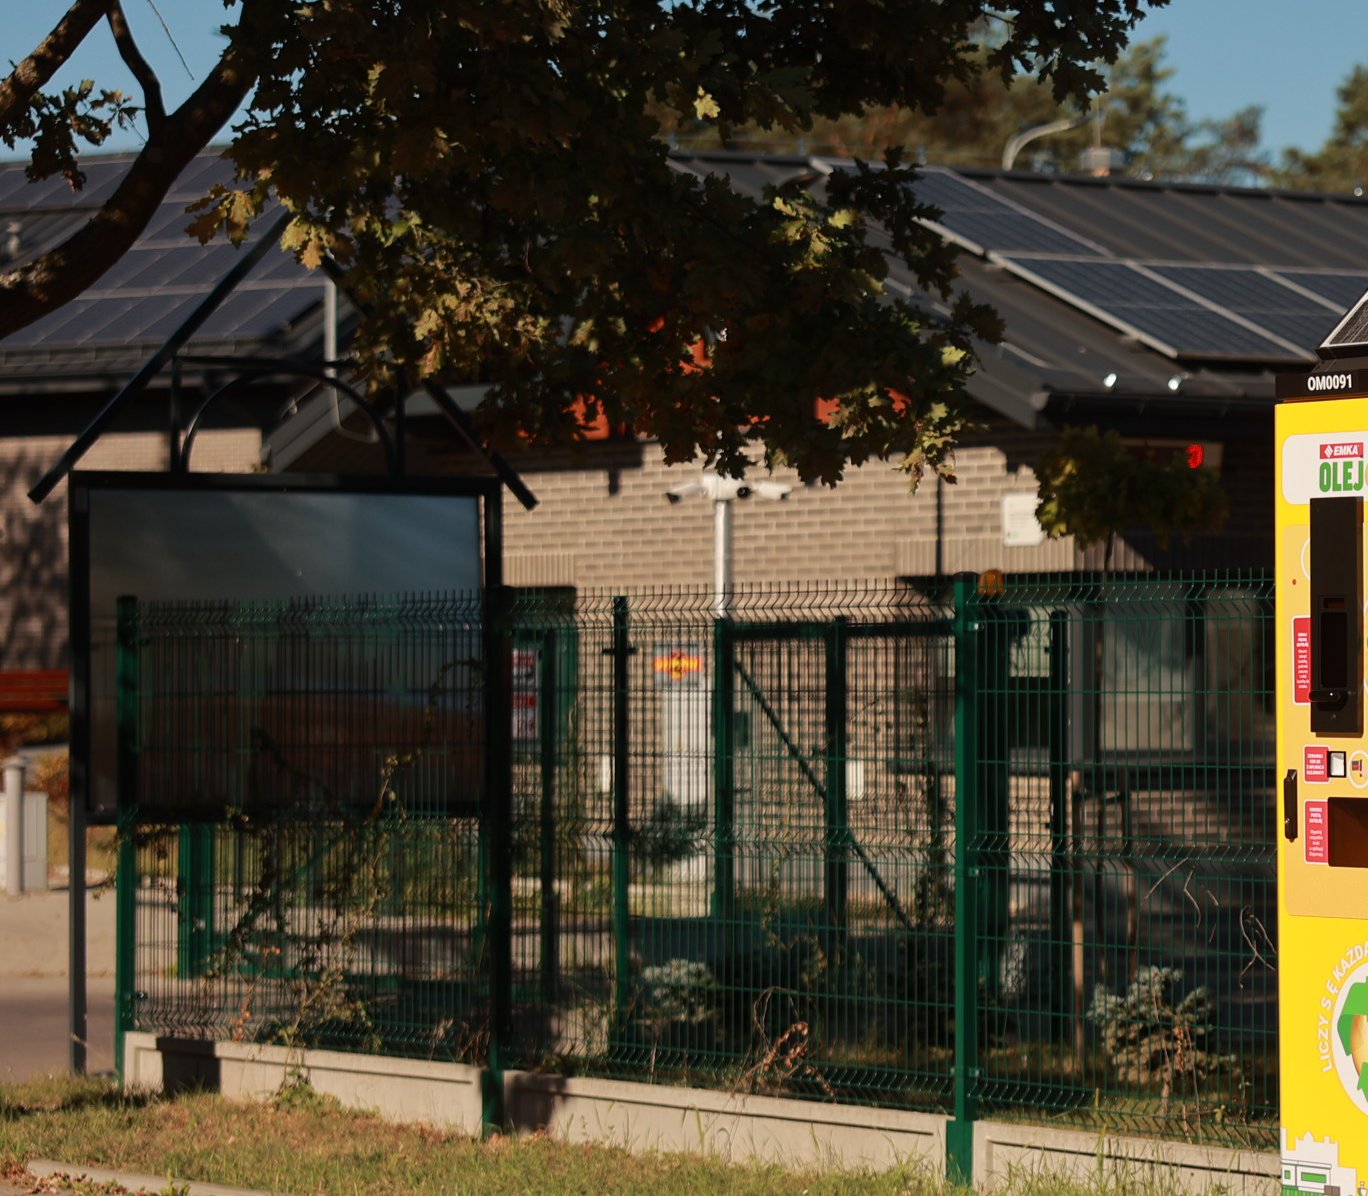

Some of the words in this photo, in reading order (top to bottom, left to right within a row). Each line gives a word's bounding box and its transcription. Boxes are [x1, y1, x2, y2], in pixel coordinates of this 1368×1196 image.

[1307, 373, 1352, 391] OM0091
[1333, 445, 1359, 456] EMKA
[1318, 1013, 1333, 1072] LICZY
